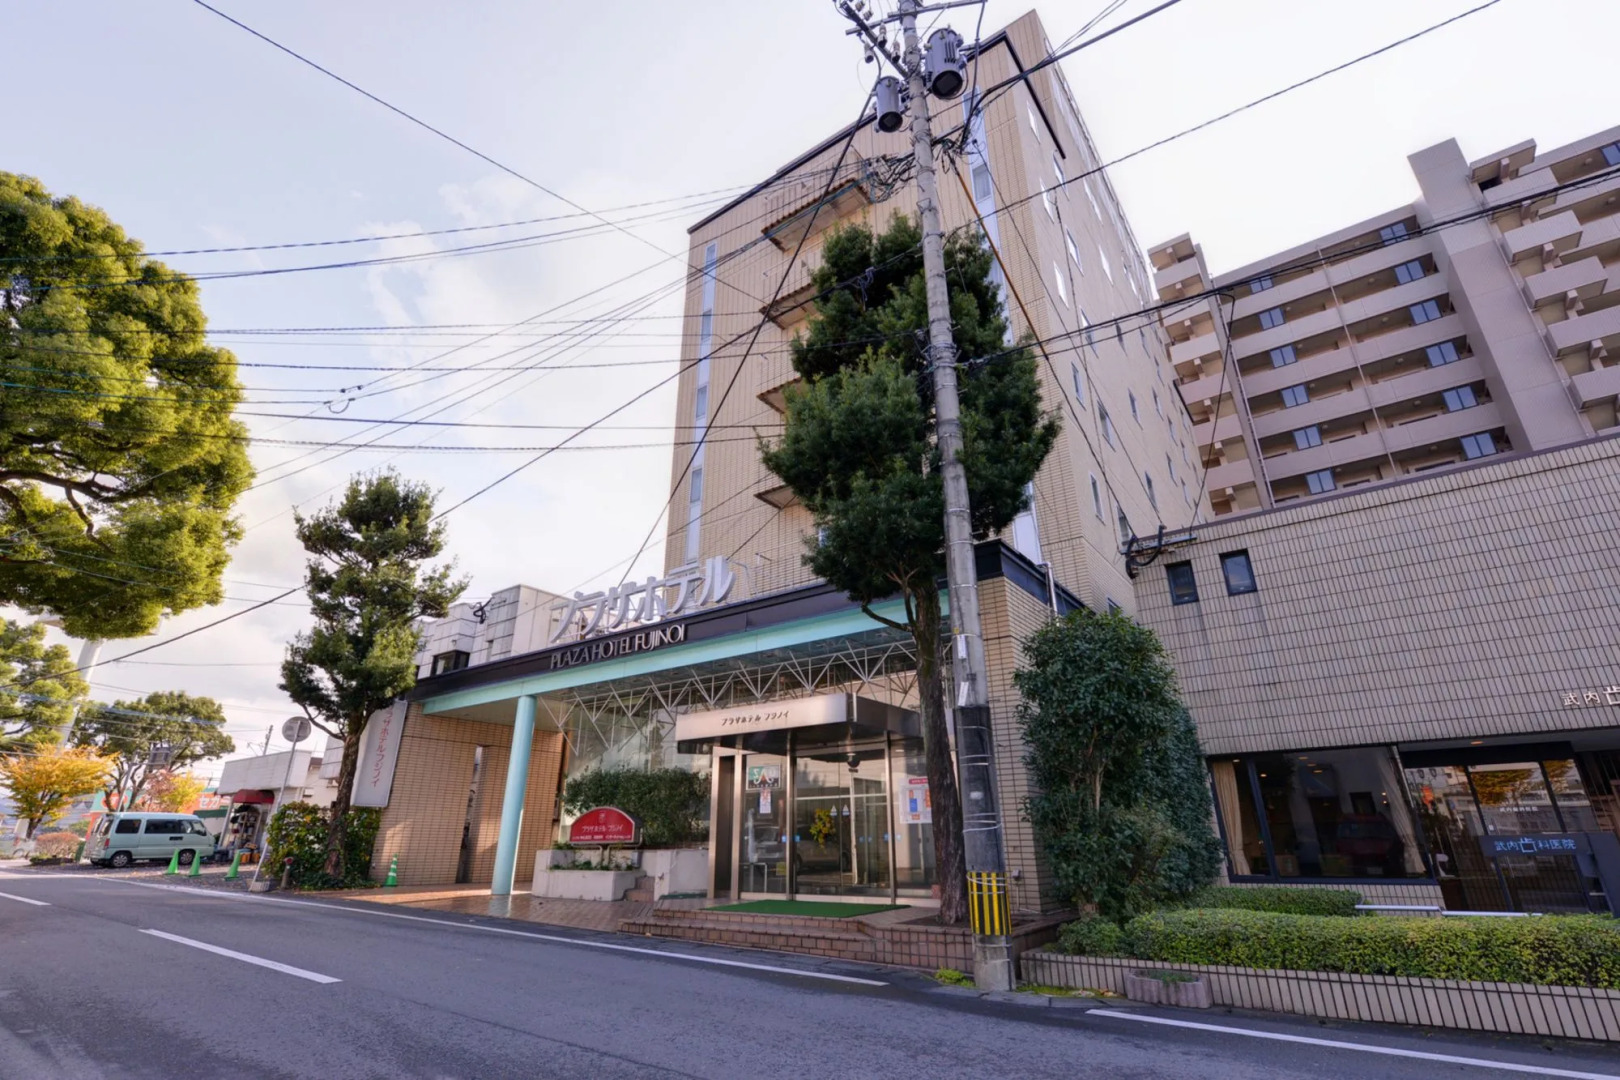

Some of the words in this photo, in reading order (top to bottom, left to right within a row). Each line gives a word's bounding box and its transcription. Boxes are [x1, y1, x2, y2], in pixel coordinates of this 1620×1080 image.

[550, 647, 591, 669] PLAZA
[591, 636, 633, 660] HOTEL
[634, 624, 685, 651] FUJINOI
[1494, 837, 1577, 853] 武内歯科医院
